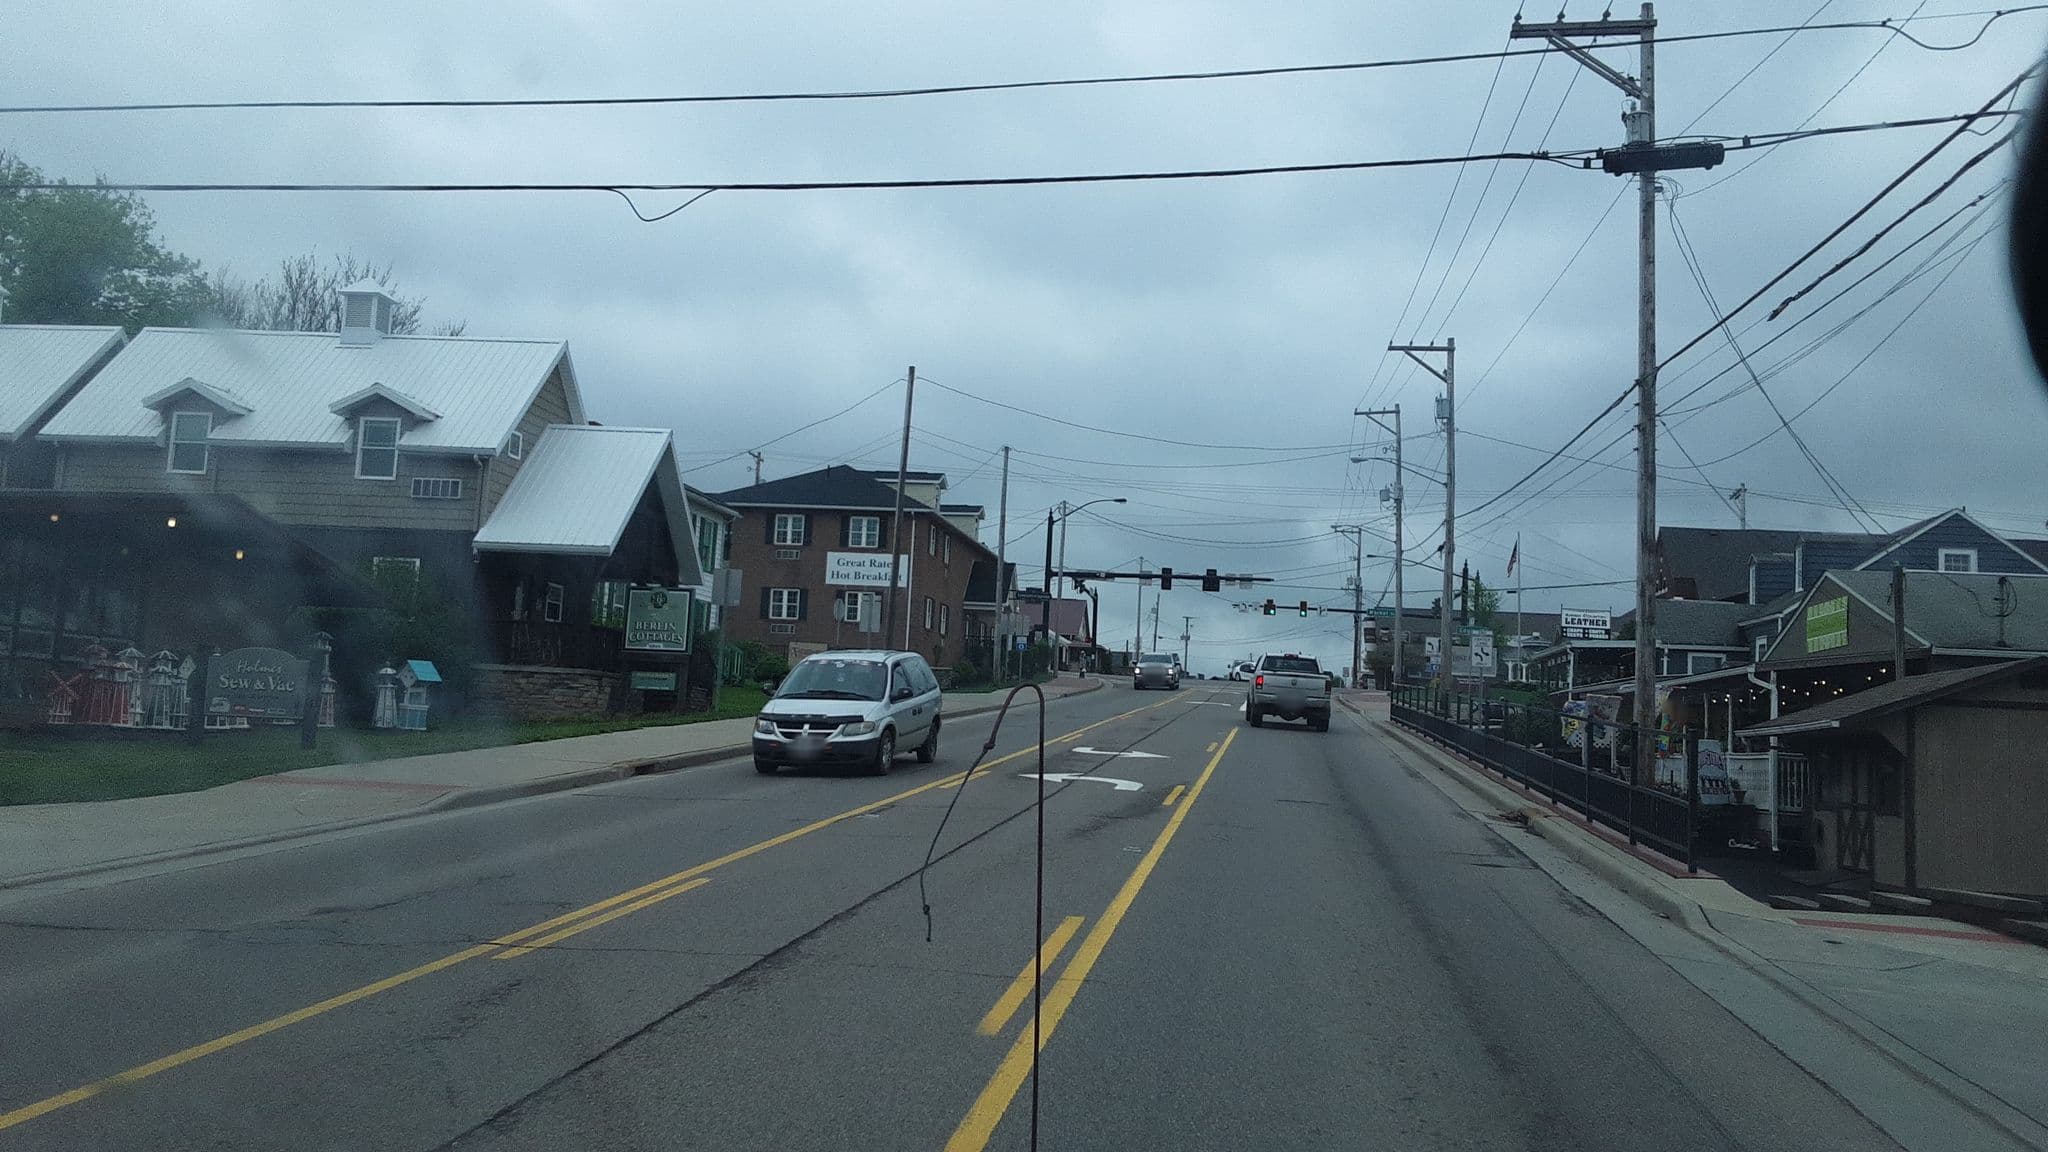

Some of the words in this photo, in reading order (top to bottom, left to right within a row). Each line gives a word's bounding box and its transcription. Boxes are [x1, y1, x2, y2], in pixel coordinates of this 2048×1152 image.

[837, 558, 866, 567] Great
[869, 559, 894, 569] Rate
[831, 571, 850, 580] Hot
[854, 571, 902, 582] Breakfat
[635, 621, 676, 632] BERLIN
[1564, 617, 1608, 627] LEATHER
[629, 632, 683, 645] COTTAGES
[219, 674, 251, 689] Sew
[254, 679, 266, 690] &
[268, 676, 295, 692] Vac
